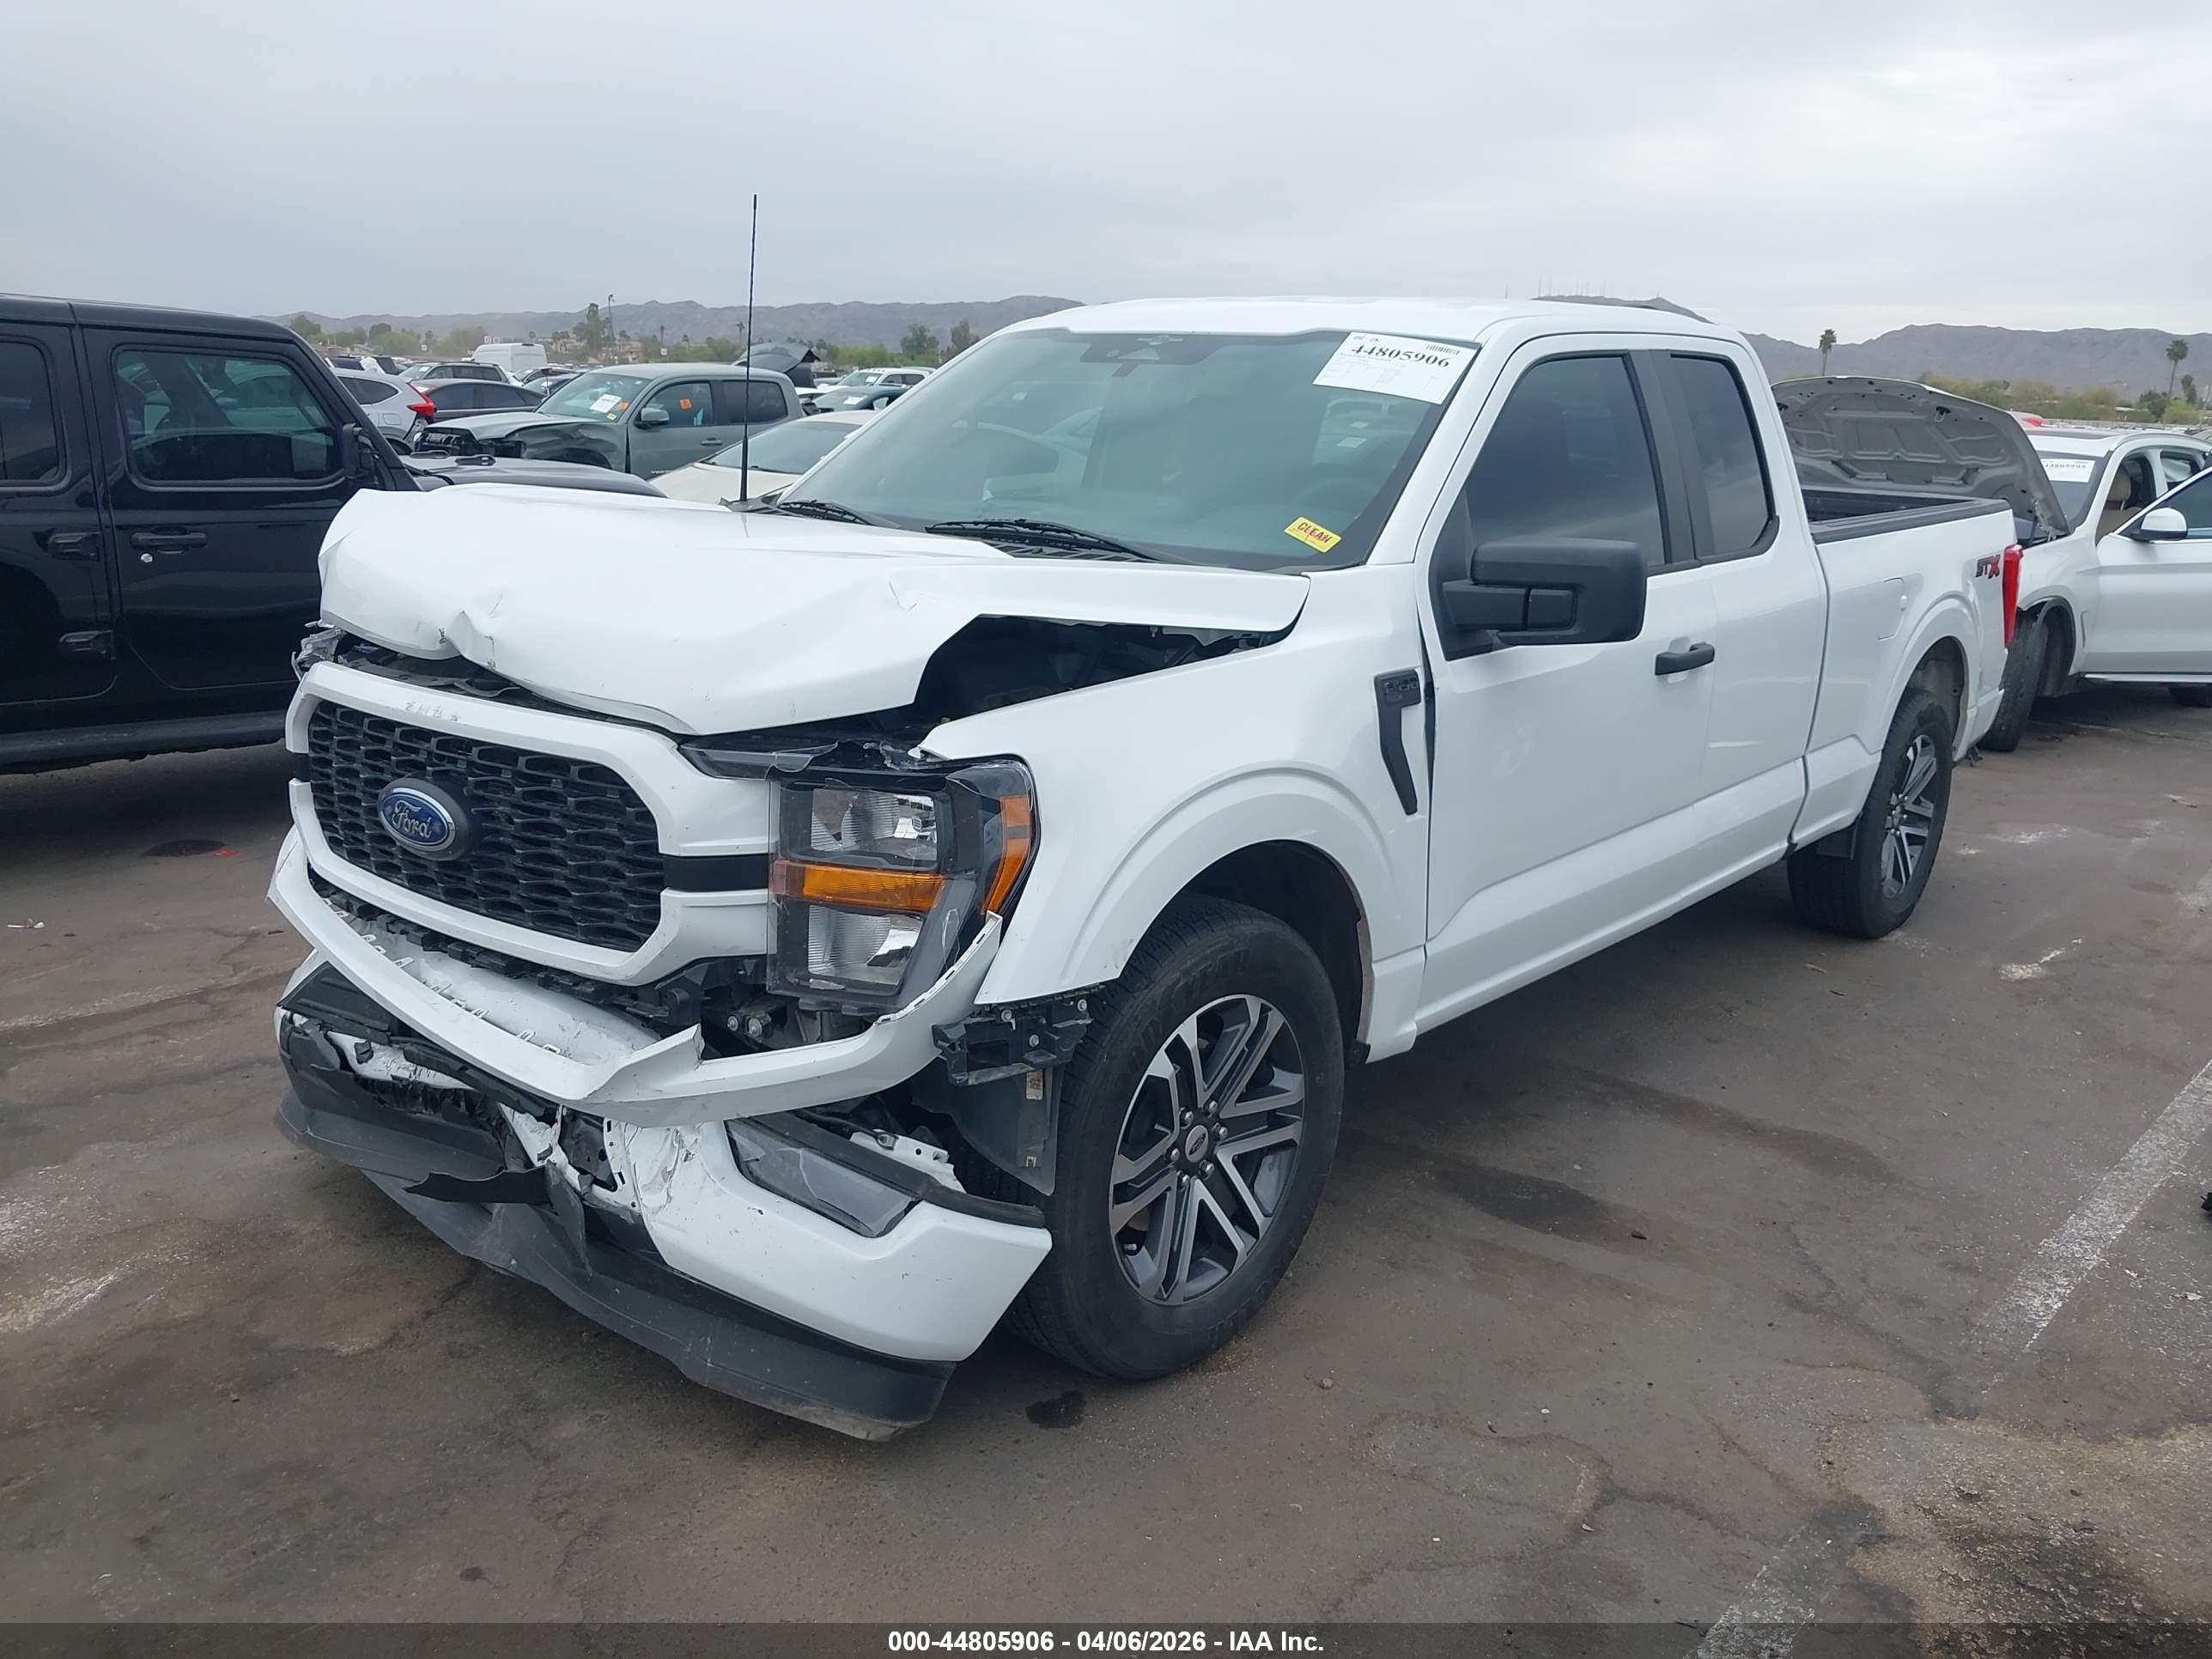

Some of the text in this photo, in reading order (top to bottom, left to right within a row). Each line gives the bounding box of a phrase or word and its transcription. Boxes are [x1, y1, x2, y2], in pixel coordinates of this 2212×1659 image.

[1352, 343, 1449, 368] 44805906
[1297, 521, 1333, 544] CLEAN
[392, 799, 432, 839] Ford
